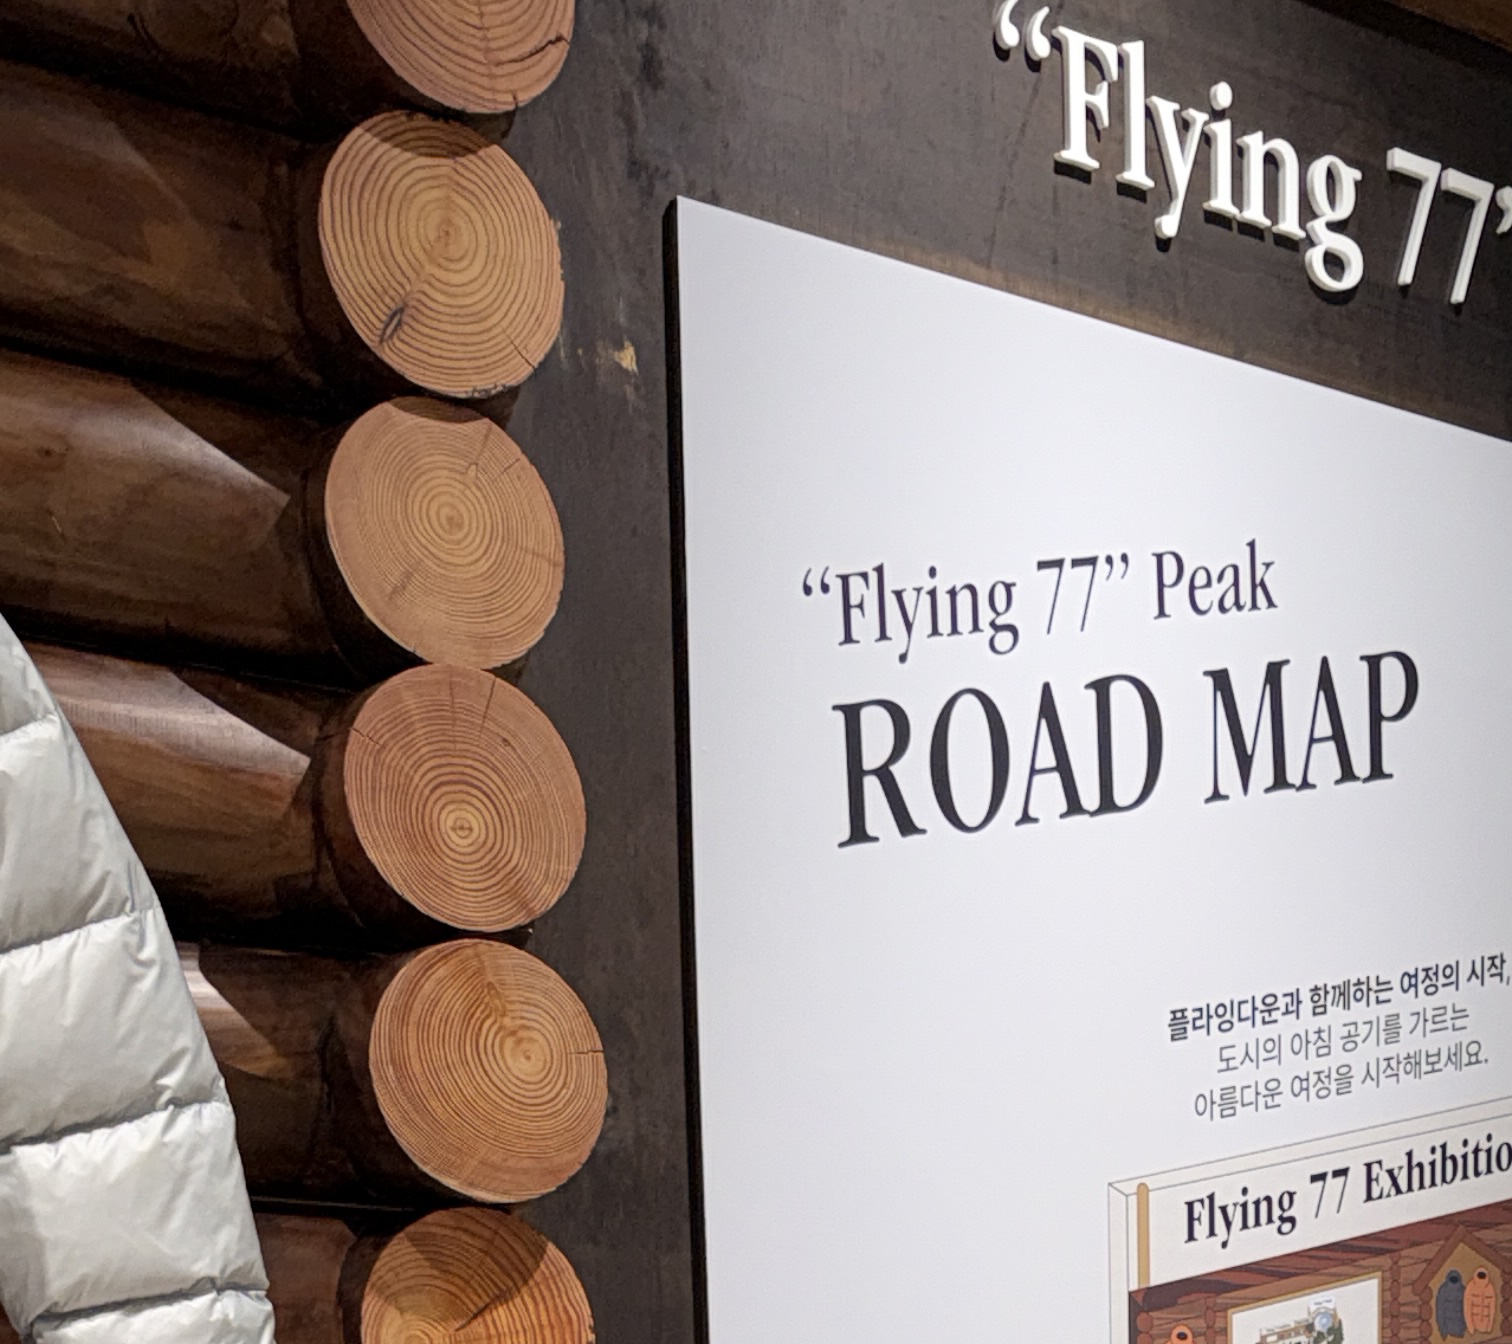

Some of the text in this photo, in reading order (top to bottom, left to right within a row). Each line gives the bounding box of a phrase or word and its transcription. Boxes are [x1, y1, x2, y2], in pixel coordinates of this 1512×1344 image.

[802, 538, 1279, 664] “Flying 77” Peak
[832, 650, 1419, 848] ROAD MAP
[1168, 952, 1511, 1042] 플라잉다운과 함께하는 여정의 시작,
[1217, 1002, 1470, 1074] 도시의 아침 공기를 가르는
[1195, 1039, 1489, 1122] 아름다운 여정을 시작해보세요.
[1185, 1186, 1297, 1248] Flying
[1310, 1167, 1350, 1219] 77
